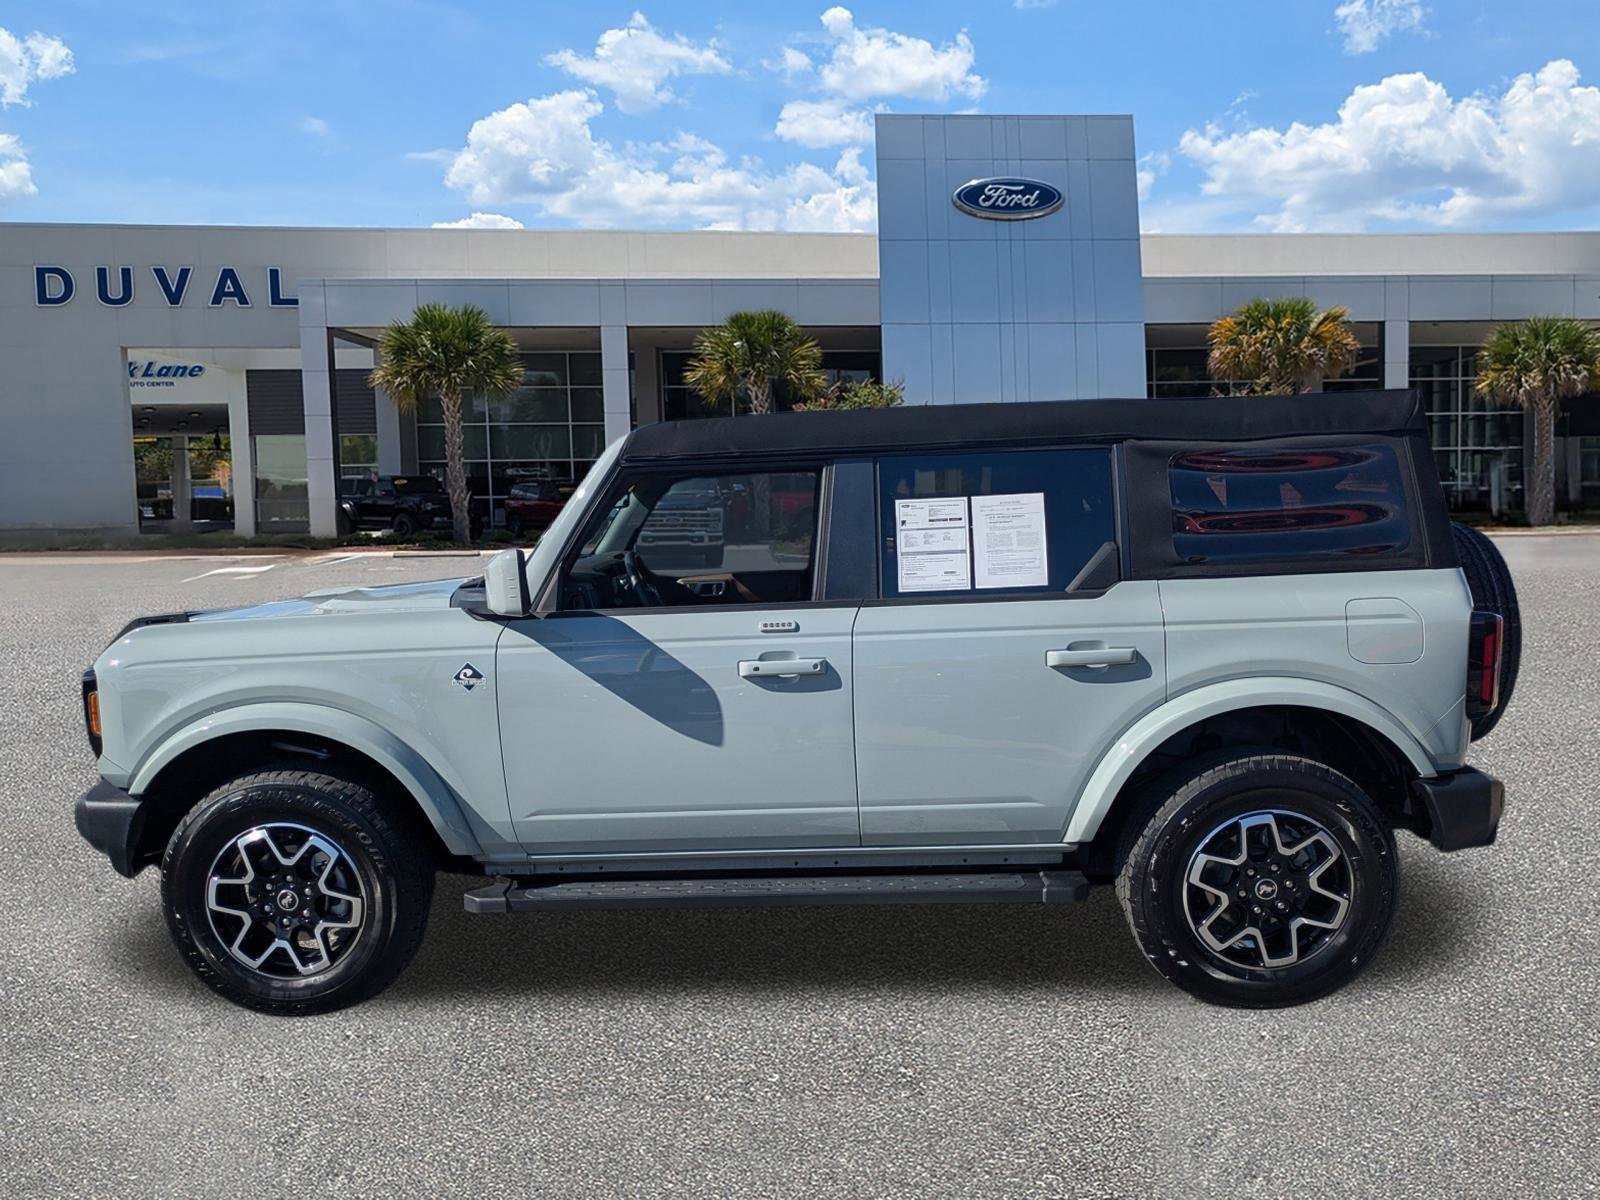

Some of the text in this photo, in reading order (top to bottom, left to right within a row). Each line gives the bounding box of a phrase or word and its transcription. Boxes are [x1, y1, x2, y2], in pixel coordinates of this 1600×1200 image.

[979, 184, 1040, 207] Ford
[33, 265, 300, 308] DUVAL
[141, 361, 205, 378] Lane
